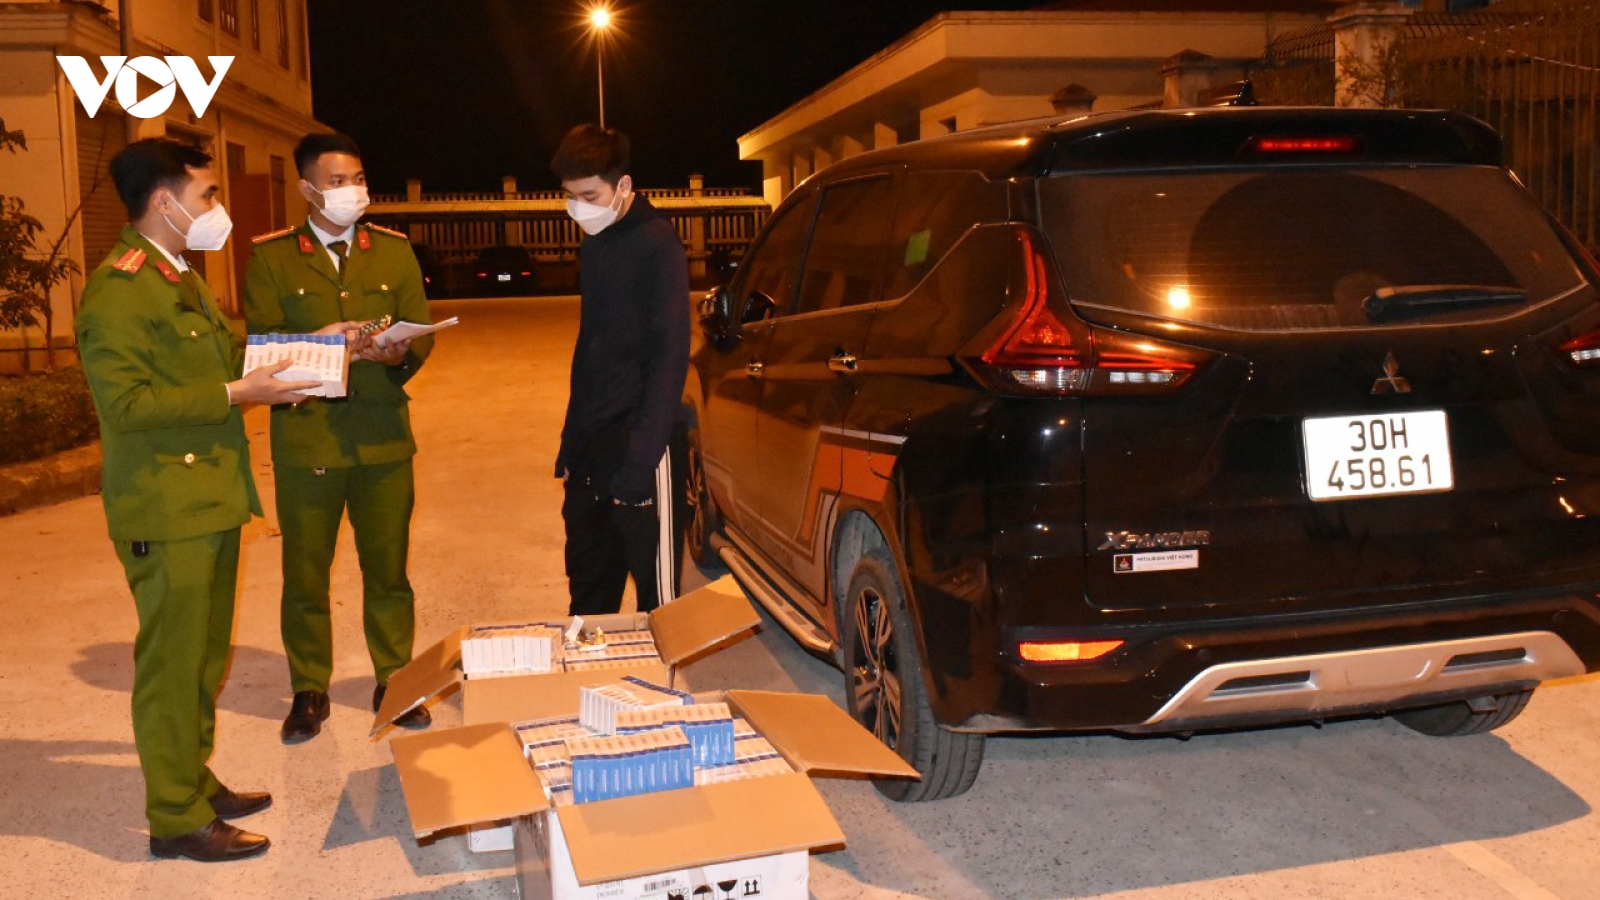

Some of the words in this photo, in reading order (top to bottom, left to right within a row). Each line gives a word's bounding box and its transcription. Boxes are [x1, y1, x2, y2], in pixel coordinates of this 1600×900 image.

[1349, 418, 1408, 452] 30H
[1328, 454, 1432, 491] 458.61
[1097, 530, 1210, 551] XPANDER
